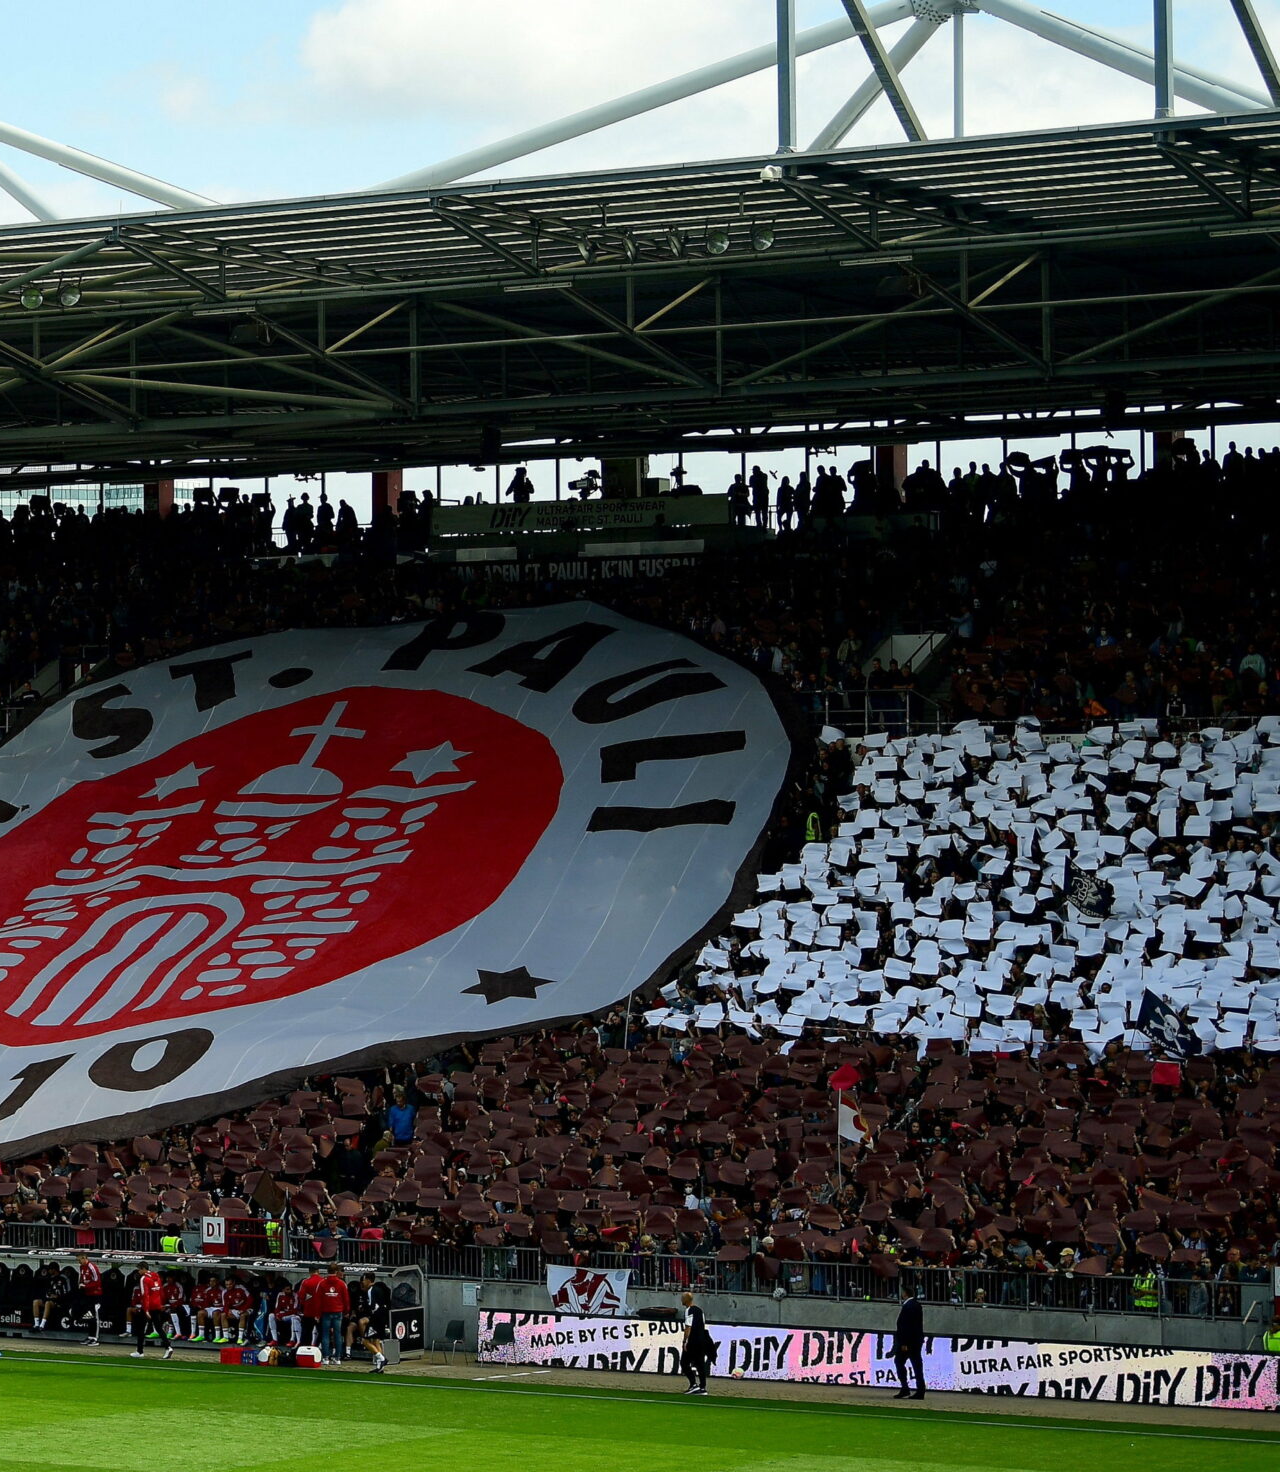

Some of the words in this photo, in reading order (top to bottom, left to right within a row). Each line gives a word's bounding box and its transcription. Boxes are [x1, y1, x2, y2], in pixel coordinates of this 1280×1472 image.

[537, 503, 571, 517] ULTRA
[572, 502, 594, 515] FAIR
[595, 501, 666, 514] SPORTSWEAR
[536, 515, 562, 527] MADE
[582, 514, 595, 525] FC
[596, 514, 612, 525] ST.
[613, 512, 643, 524] PAULI
[548, 561, 588, 581] PAULI
[380, 609, 747, 833] PAULI
[206, 1223, 221, 1237] D1
[73, 1319, 113, 1329] cotar
[530, 1330, 574, 1349] MADE
[579, 1328, 597, 1343] BY
[602, 1326, 619, 1340] FC
[624, 1324, 644, 1339] ST.
[649, 1321, 687, 1336] PAU
[960, 1357, 1012, 1375] ULTRA
[1016, 1354, 1053, 1370] FAIR
[1058, 1347, 1174, 1367] SPORTSWEAR
[849, 1370, 870, 1385] ST.
[875, 1367, 918, 1384] PAL
